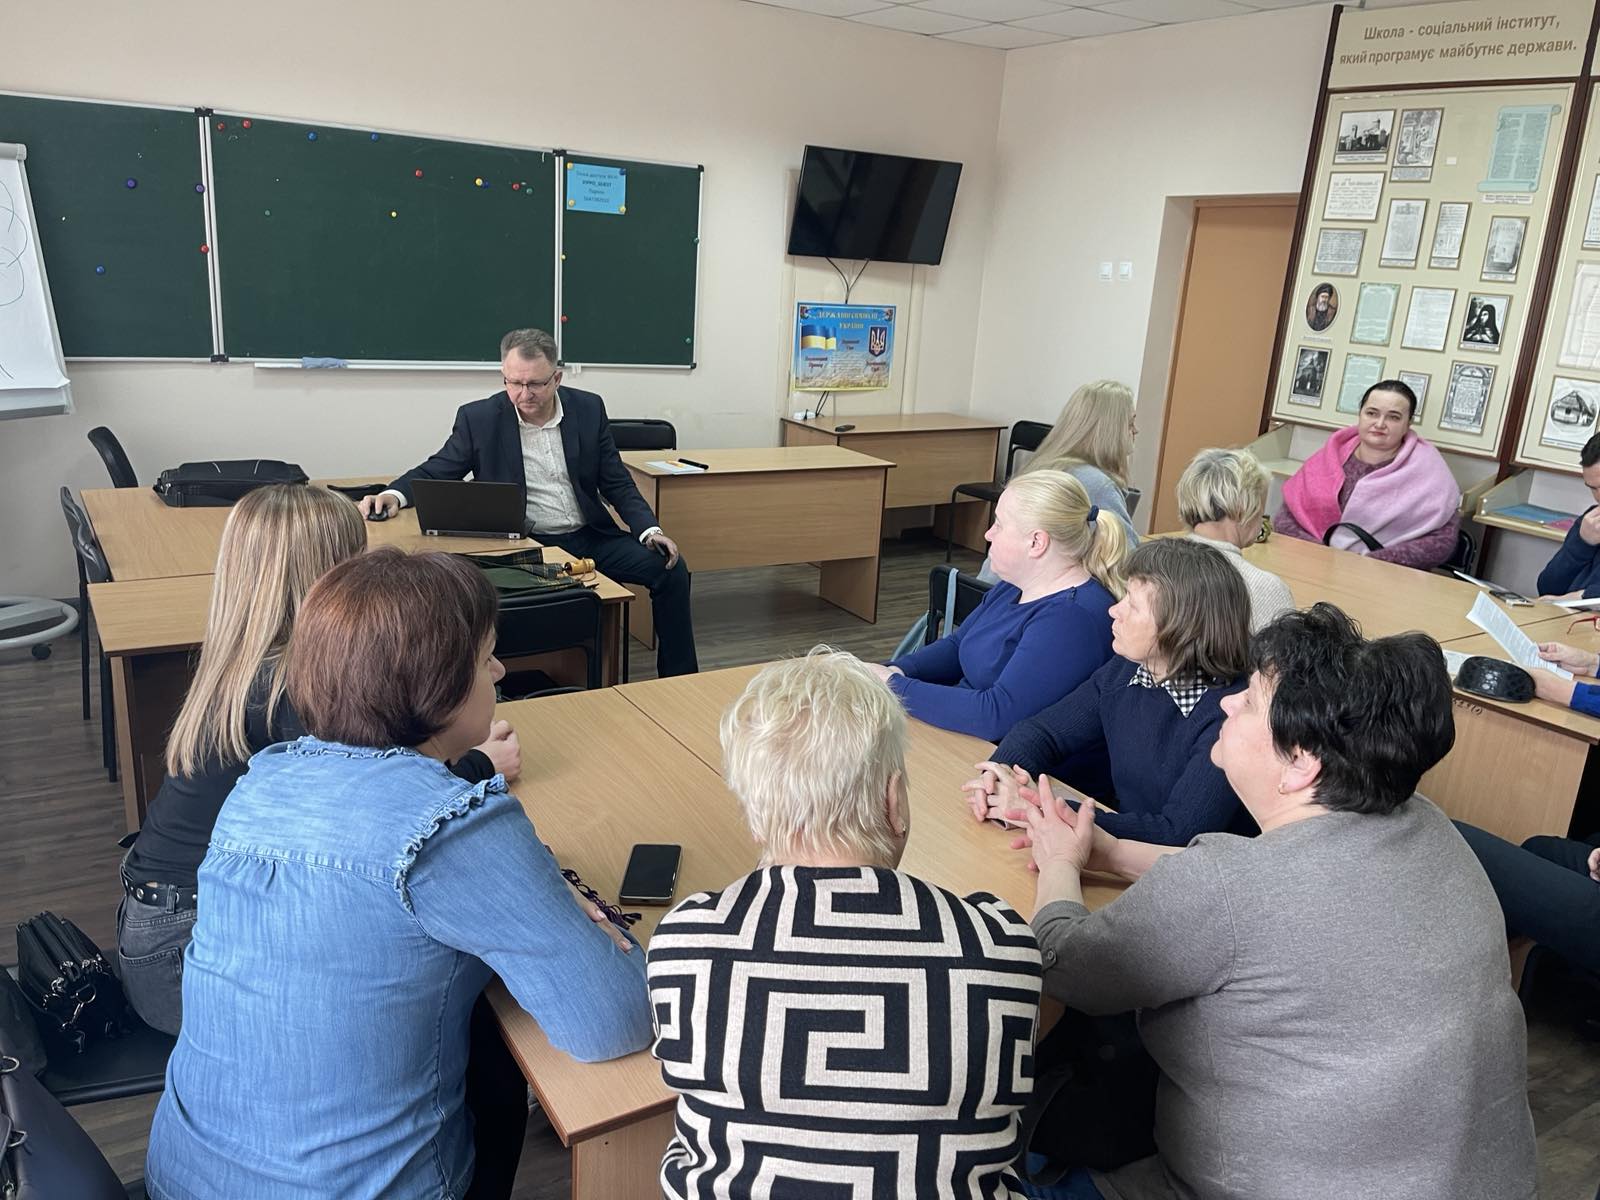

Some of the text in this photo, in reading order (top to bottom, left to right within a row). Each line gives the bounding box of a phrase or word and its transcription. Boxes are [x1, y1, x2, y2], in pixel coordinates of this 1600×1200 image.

[1364, 26, 1405, 40] Школа
[1418, 17, 1492, 36] соціальний
[1497, 15, 1560, 30] інститут,
[1340, 40, 1577, 66] який програмує майбутнє держави.
